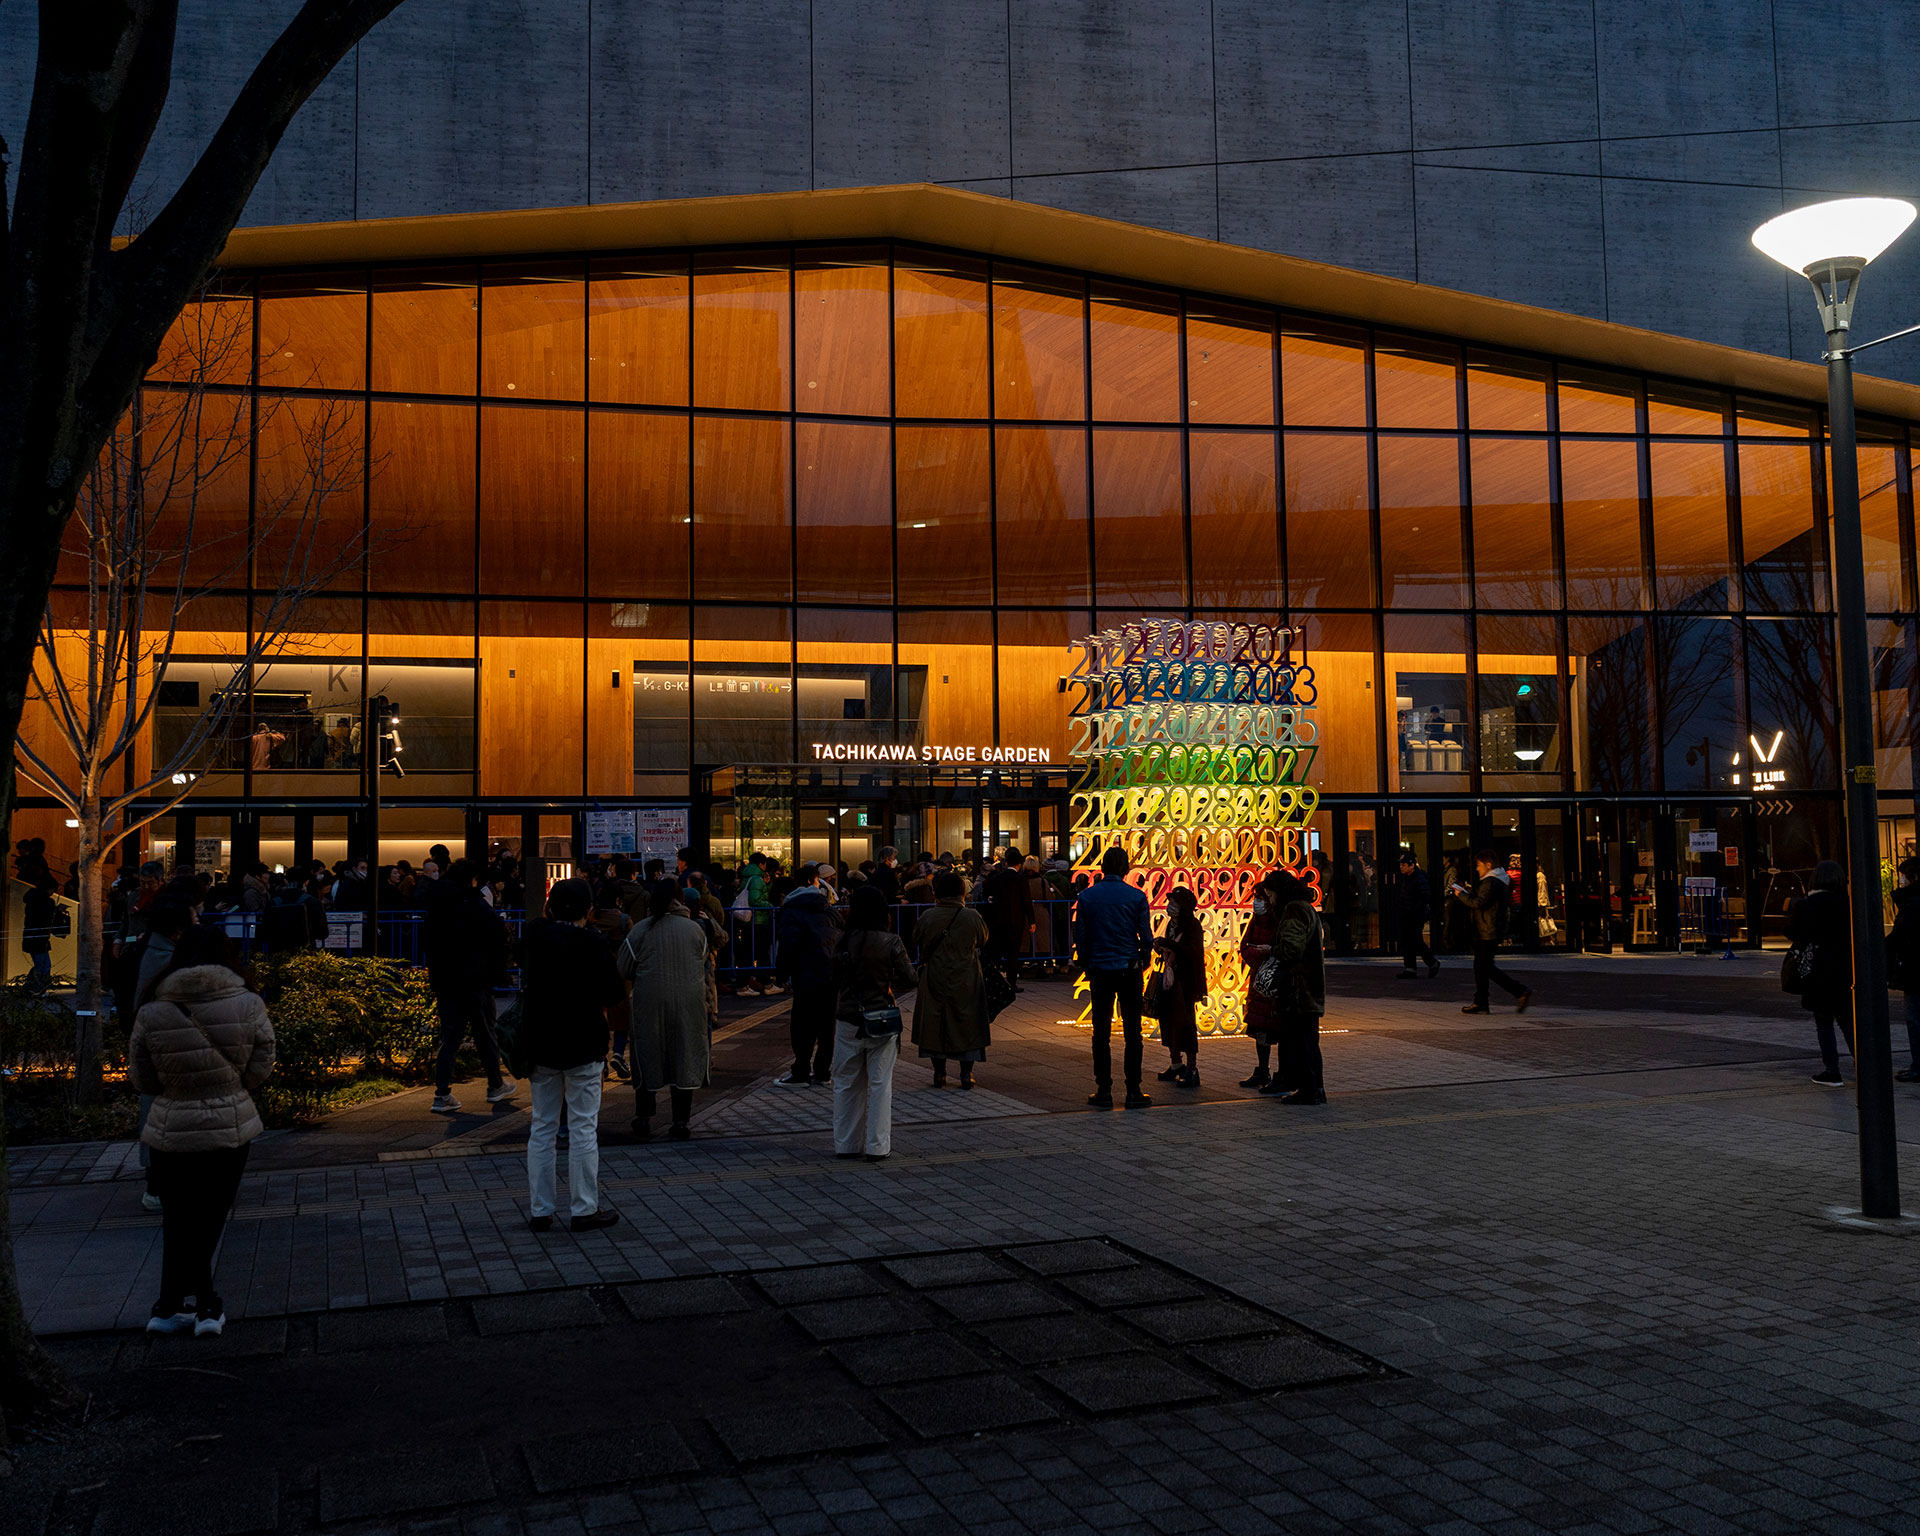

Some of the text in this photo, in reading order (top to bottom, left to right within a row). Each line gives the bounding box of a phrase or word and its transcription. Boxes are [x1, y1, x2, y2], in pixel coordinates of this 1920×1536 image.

[812, 743, 1050, 763] TACHIKAWA STAGE GARDEN
